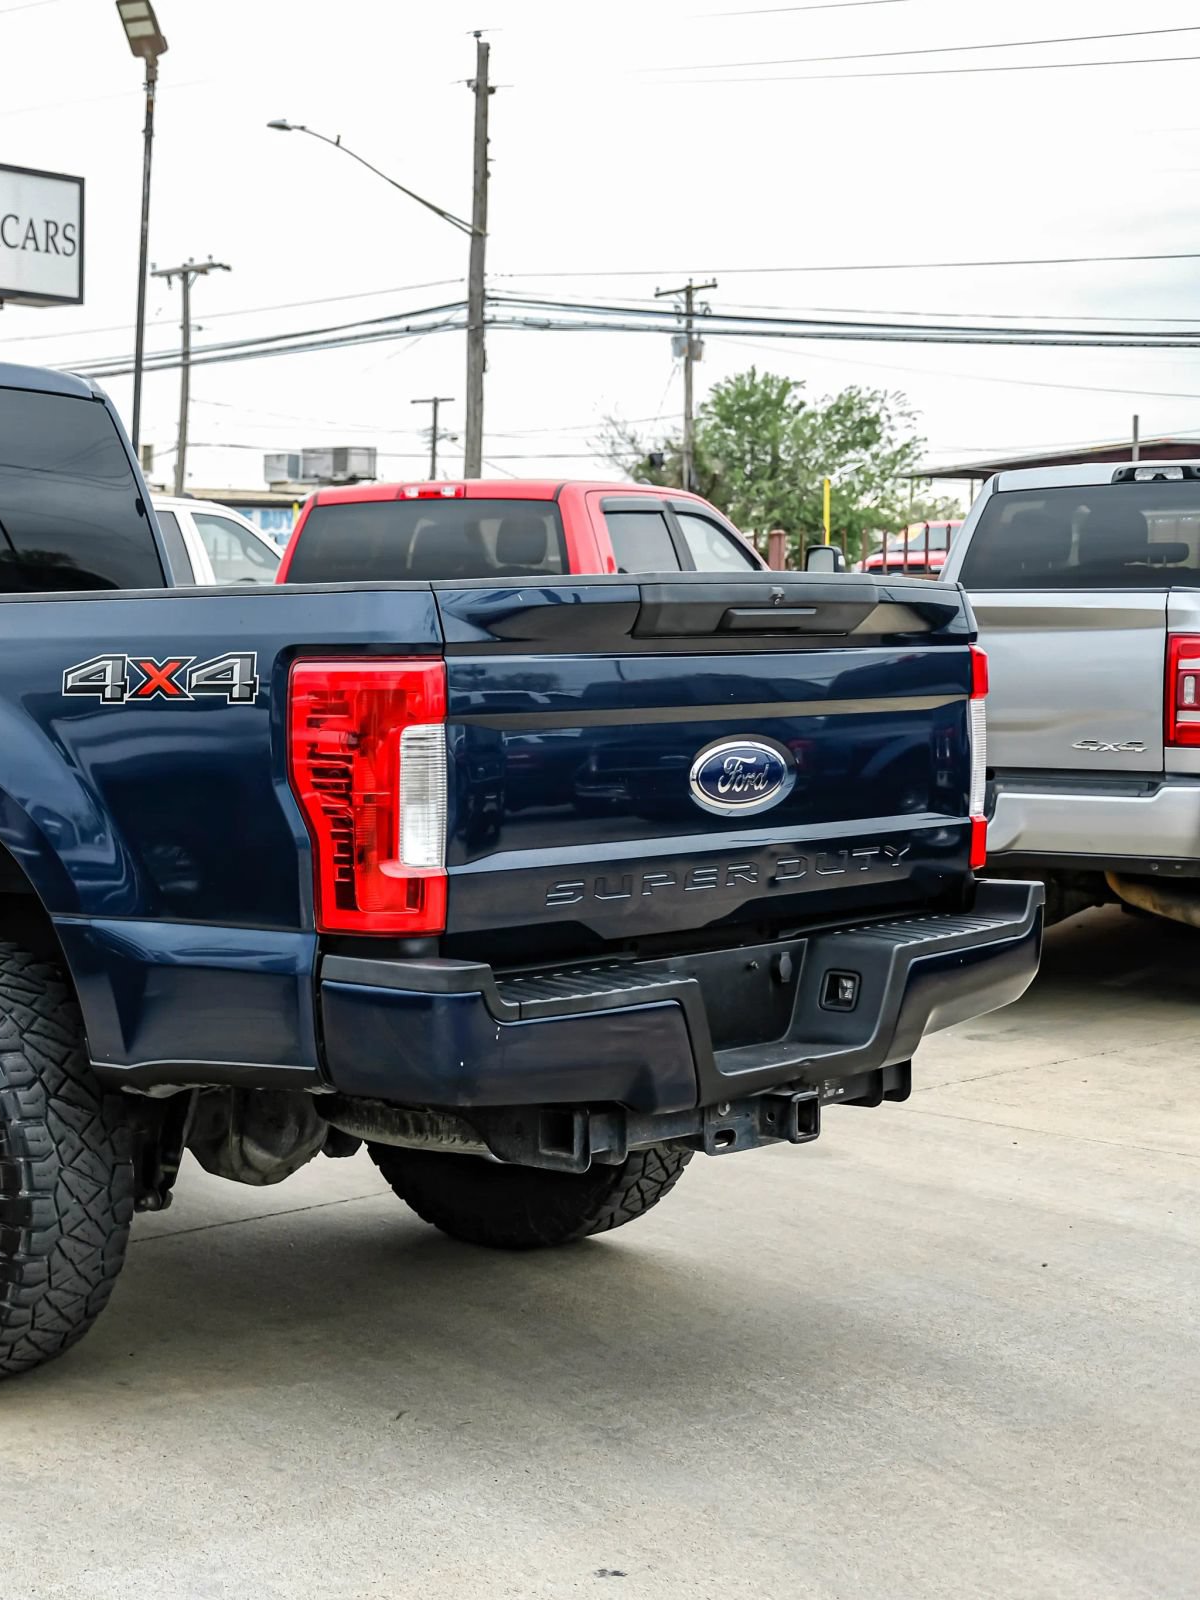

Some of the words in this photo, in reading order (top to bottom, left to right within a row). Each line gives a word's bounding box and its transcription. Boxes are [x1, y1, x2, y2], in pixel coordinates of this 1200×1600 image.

[717, 756, 769, 793] Ford
[545, 861, 761, 906] SUPER
[774, 845, 911, 881] DUTY
